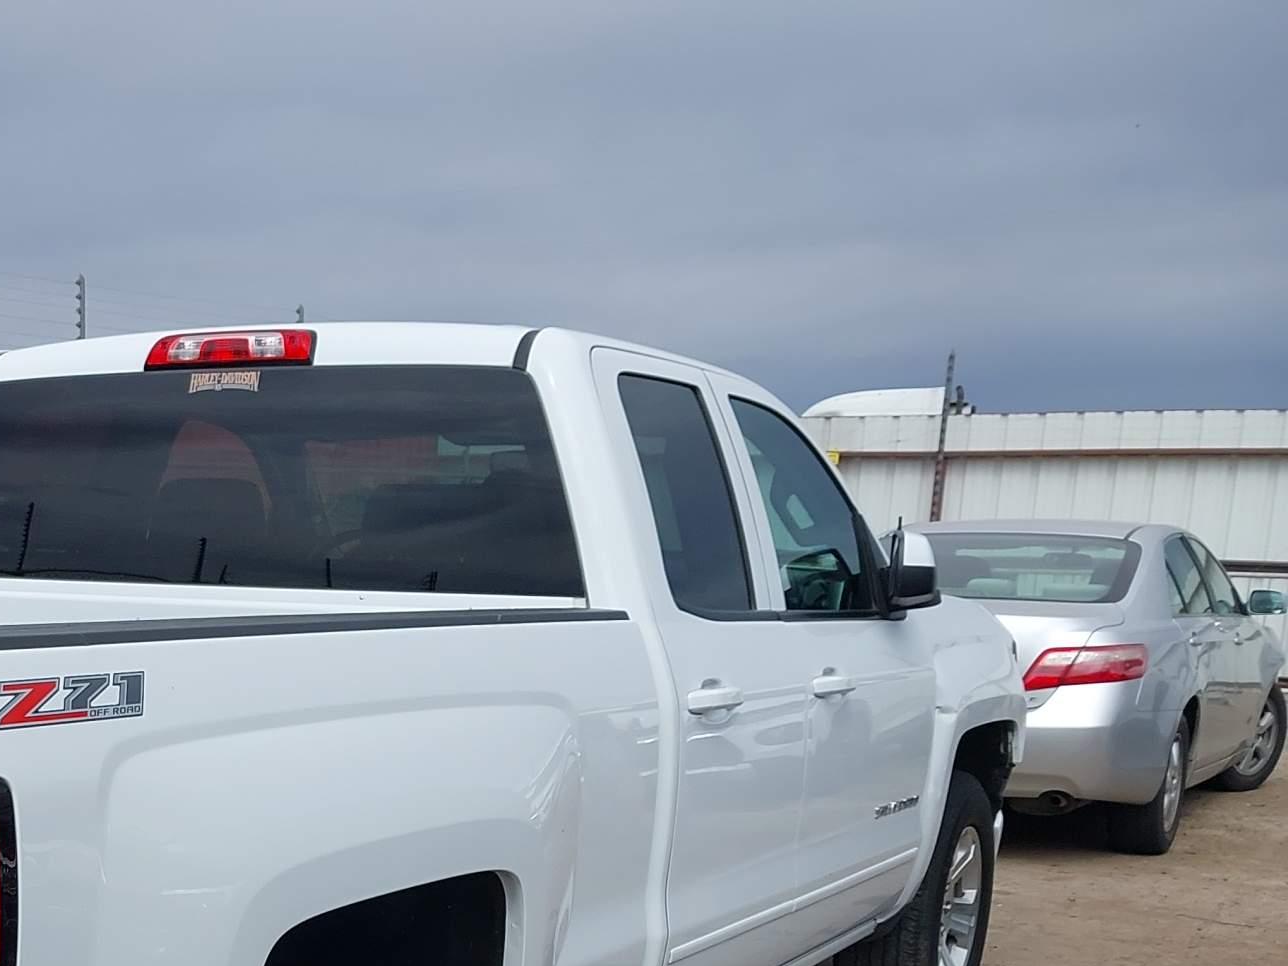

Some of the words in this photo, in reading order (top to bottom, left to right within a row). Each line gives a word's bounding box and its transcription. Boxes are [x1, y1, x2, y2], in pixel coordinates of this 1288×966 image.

[189, 371, 261, 394] HARLEY-DAVIDSON
[89, 708, 111, 718] OFF
[112, 704, 142, 716] ROAD
